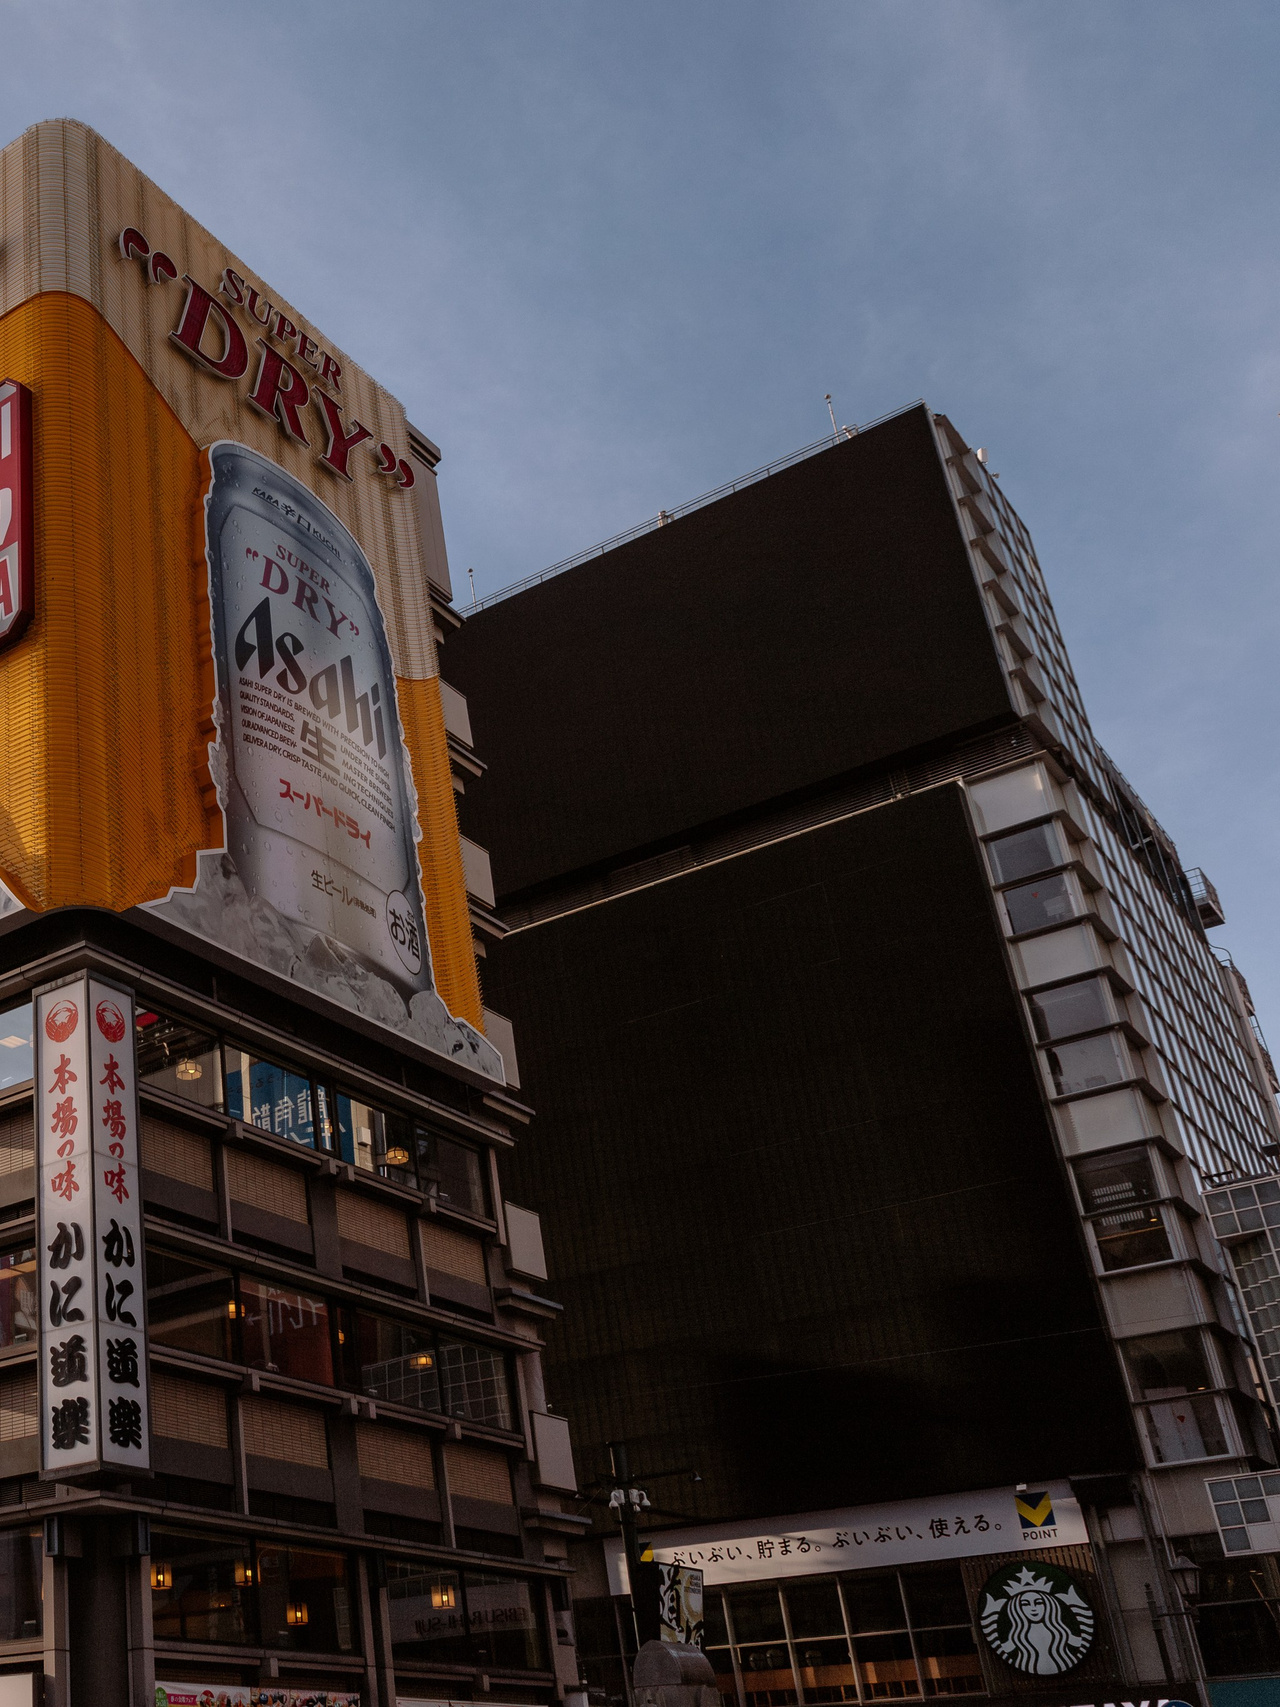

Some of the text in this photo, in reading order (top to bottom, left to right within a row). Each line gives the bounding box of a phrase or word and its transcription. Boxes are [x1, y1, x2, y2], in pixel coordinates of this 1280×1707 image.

[221, 268, 342, 394] SUPER
[252, 487, 279, 508] KARA
[312, 528, 341, 558] KUCHI
[276, 545, 330, 596] SUPER
[235, 597, 387, 760] Asahi
[239, 690, 260, 704] QUALITY
[239, 677, 254, 688] ASAHI
[254, 682, 272, 696] SUPER
[273, 691, 286, 703] DRY
[287, 698, 293, 707] IS
[294, 702, 321, 723] BREWED
[322, 719, 340, 736] WITH
[340, 732, 371, 760] PRECISION
[264, 714, 295, 735] JAPANESE
[243, 733, 263, 747] DELIVER
[282, 749, 301, 764] CRISP
[302, 759, 322, 777] TASTE
[323, 773, 338, 787] AND
[361, 799, 379, 819] CLEAN
[300, 720, 340, 777] 生
[340, 745, 362, 768] UNDER
[363, 763, 375, 777] THE
[341, 759, 368, 783] MASTER
[279, 778, 372, 849] スーパードライ
[343, 772, 394, 819] ING TECHNIQUES
[389, 908, 421, 961] お酒
[48, 1053, 80, 1202] 本場の味
[99, 1053, 130, 1205] 本場の味
[1022, 1528, 1058, 1541] POINT
